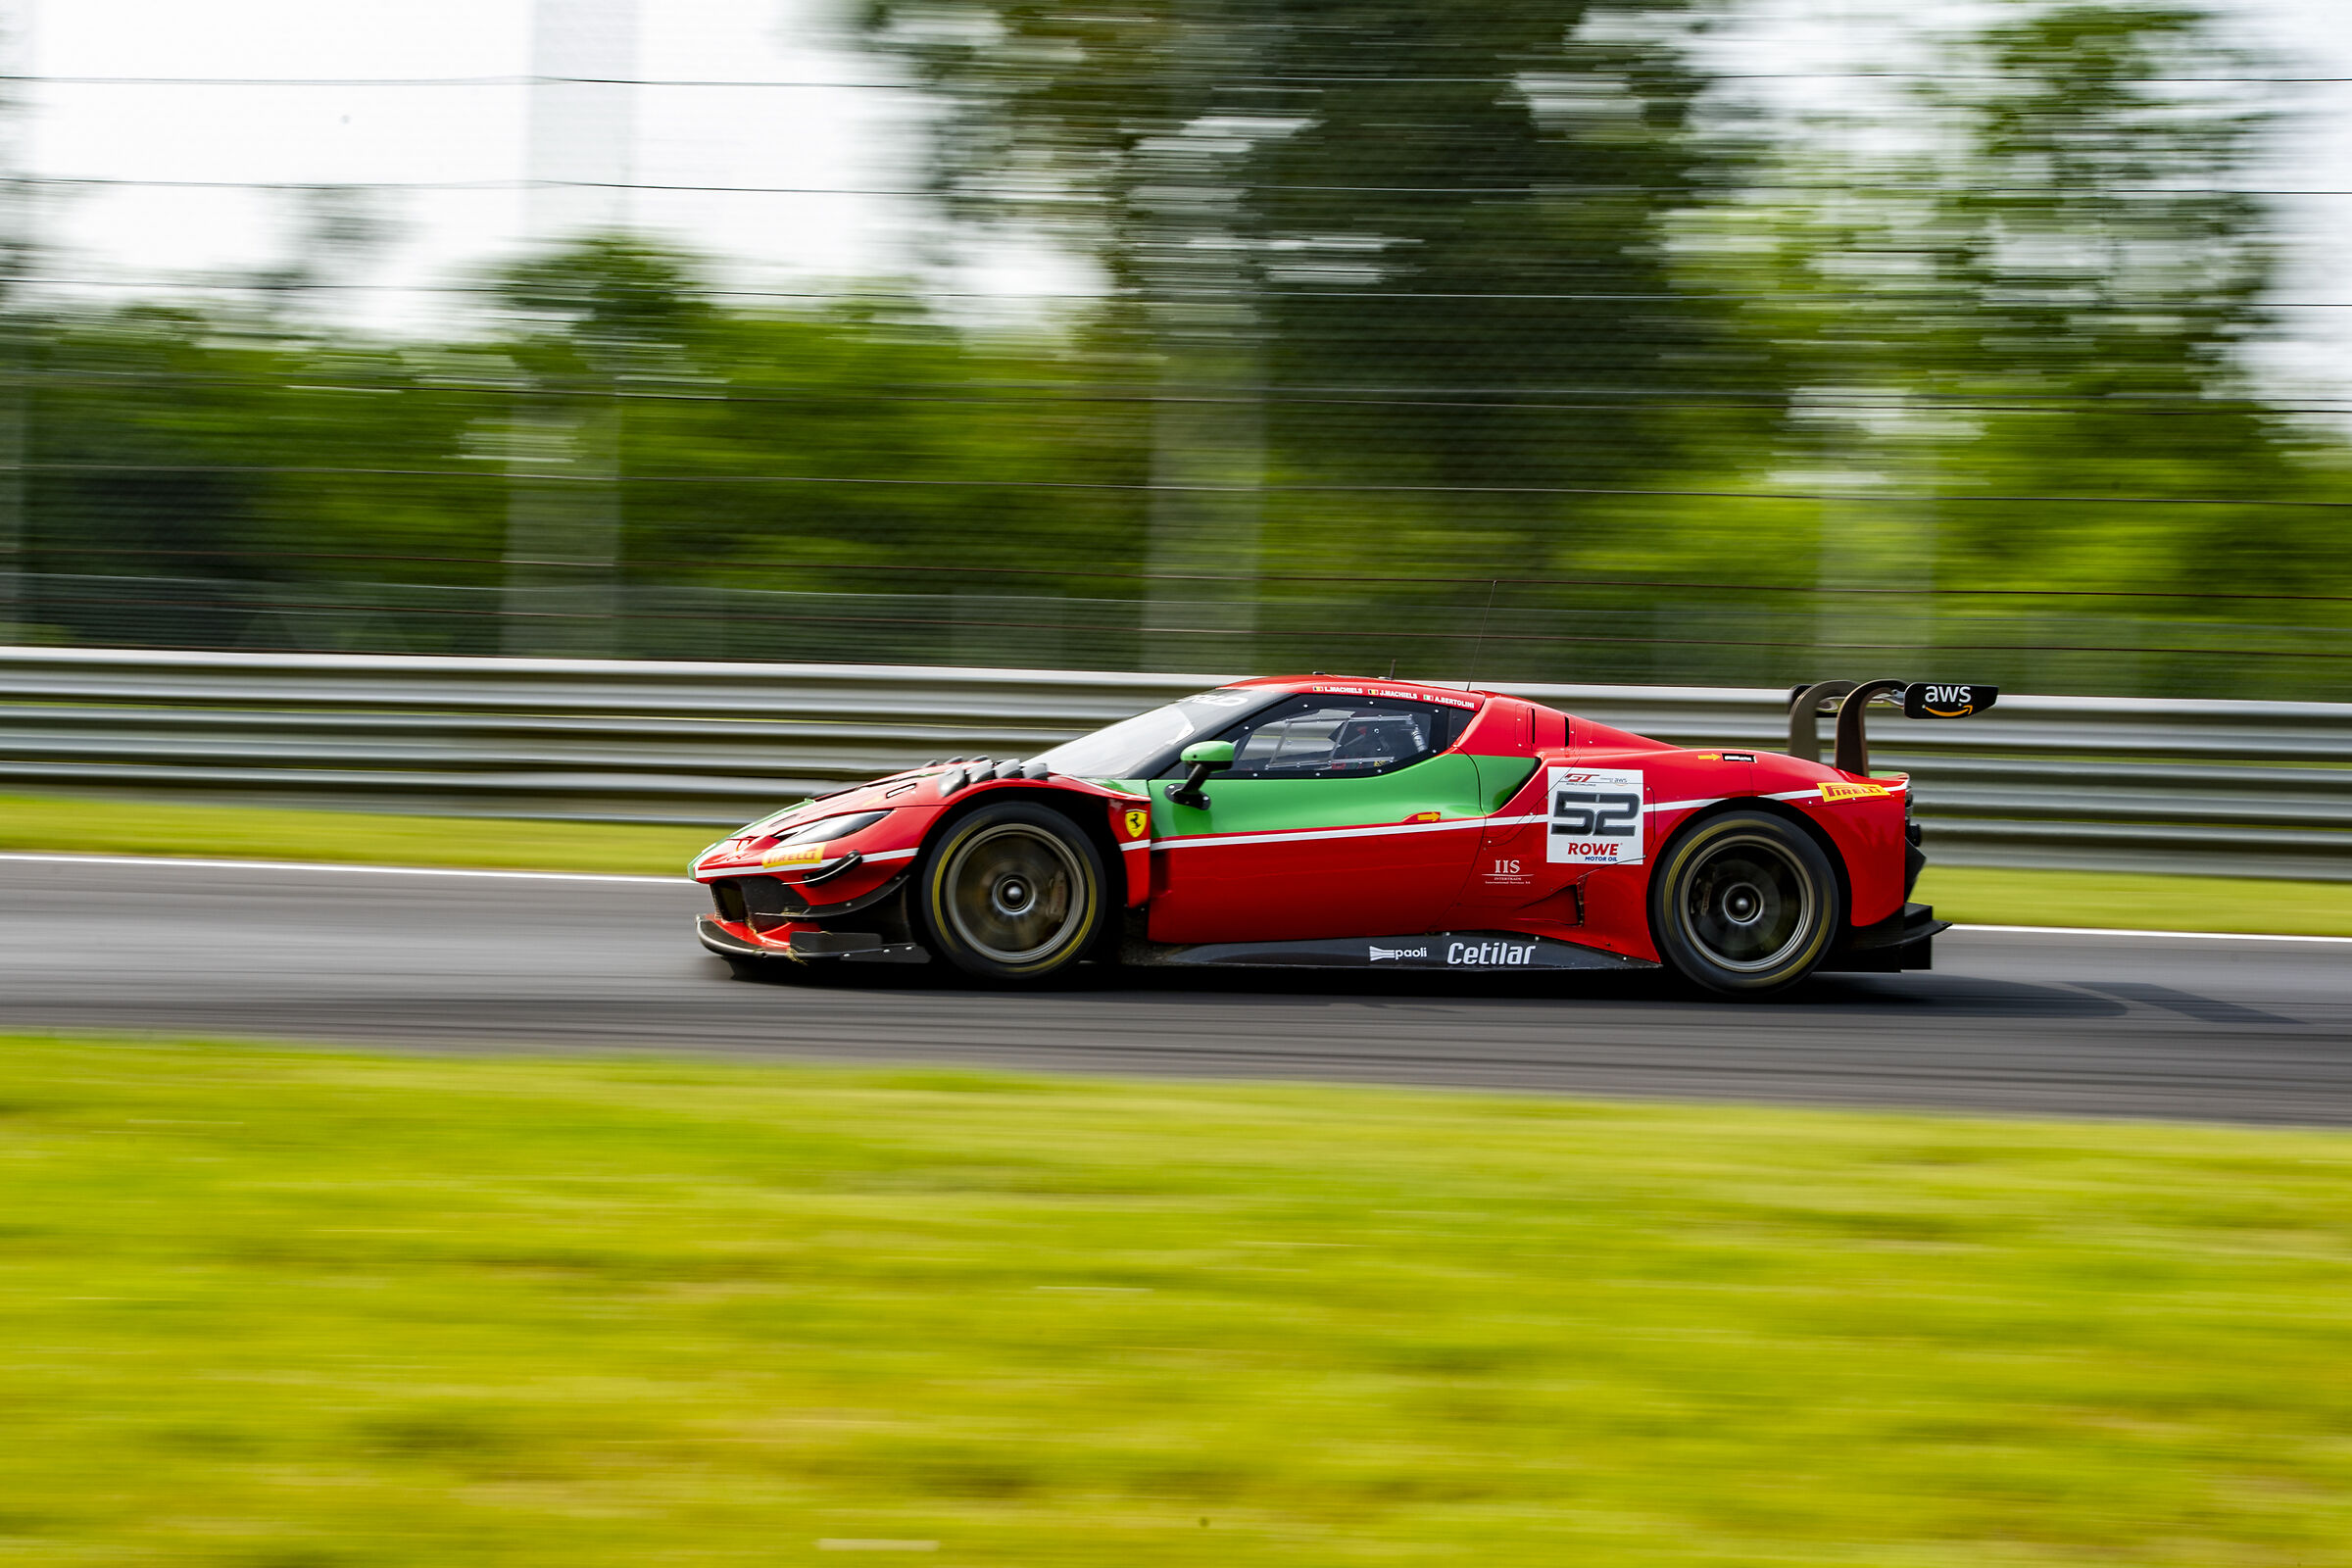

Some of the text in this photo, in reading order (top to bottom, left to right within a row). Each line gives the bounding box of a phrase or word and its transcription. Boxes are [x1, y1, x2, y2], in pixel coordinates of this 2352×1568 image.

[1379, 689, 1418, 700] J.MACHIELS
[1925, 685, 1972, 704] aws
[1434, 696, 1475, 709] A.BERTOLINI
[1825, 785, 1882, 798] PIRELLI
[1550, 790, 1641, 837] 52
[1568, 842, 1619, 856] ROWE
[1494, 859, 1521, 874] IIS
[1395, 947, 1428, 960] paoli
[1446, 942, 1537, 965] Cetilar
